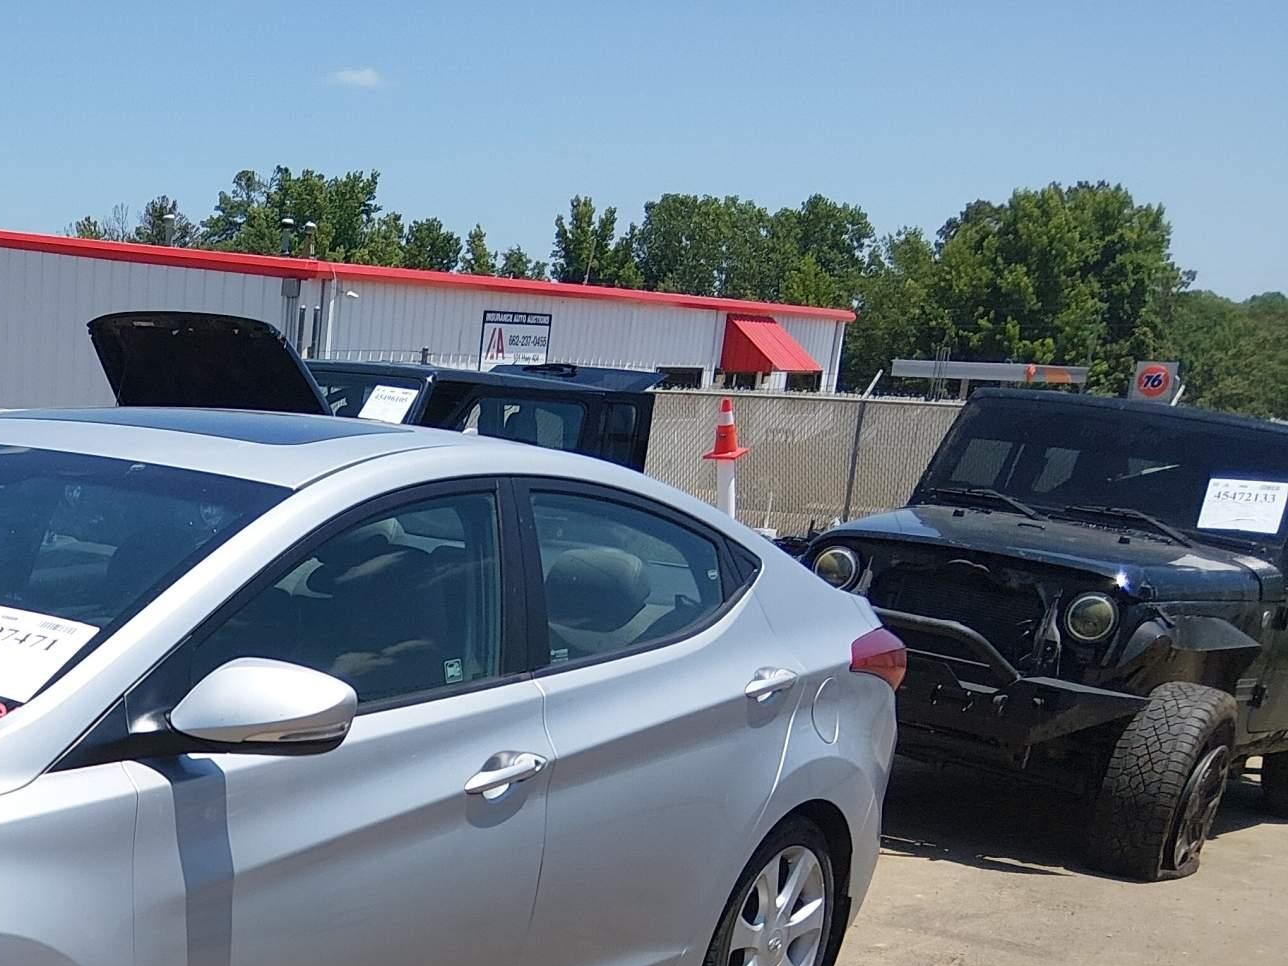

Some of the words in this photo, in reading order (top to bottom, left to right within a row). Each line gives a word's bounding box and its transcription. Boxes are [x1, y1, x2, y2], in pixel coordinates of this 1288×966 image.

[513, 314, 527, 323] AUTO
[1143, 373, 1164, 388] 76
[1214, 490, 1277, 503] 45472133
